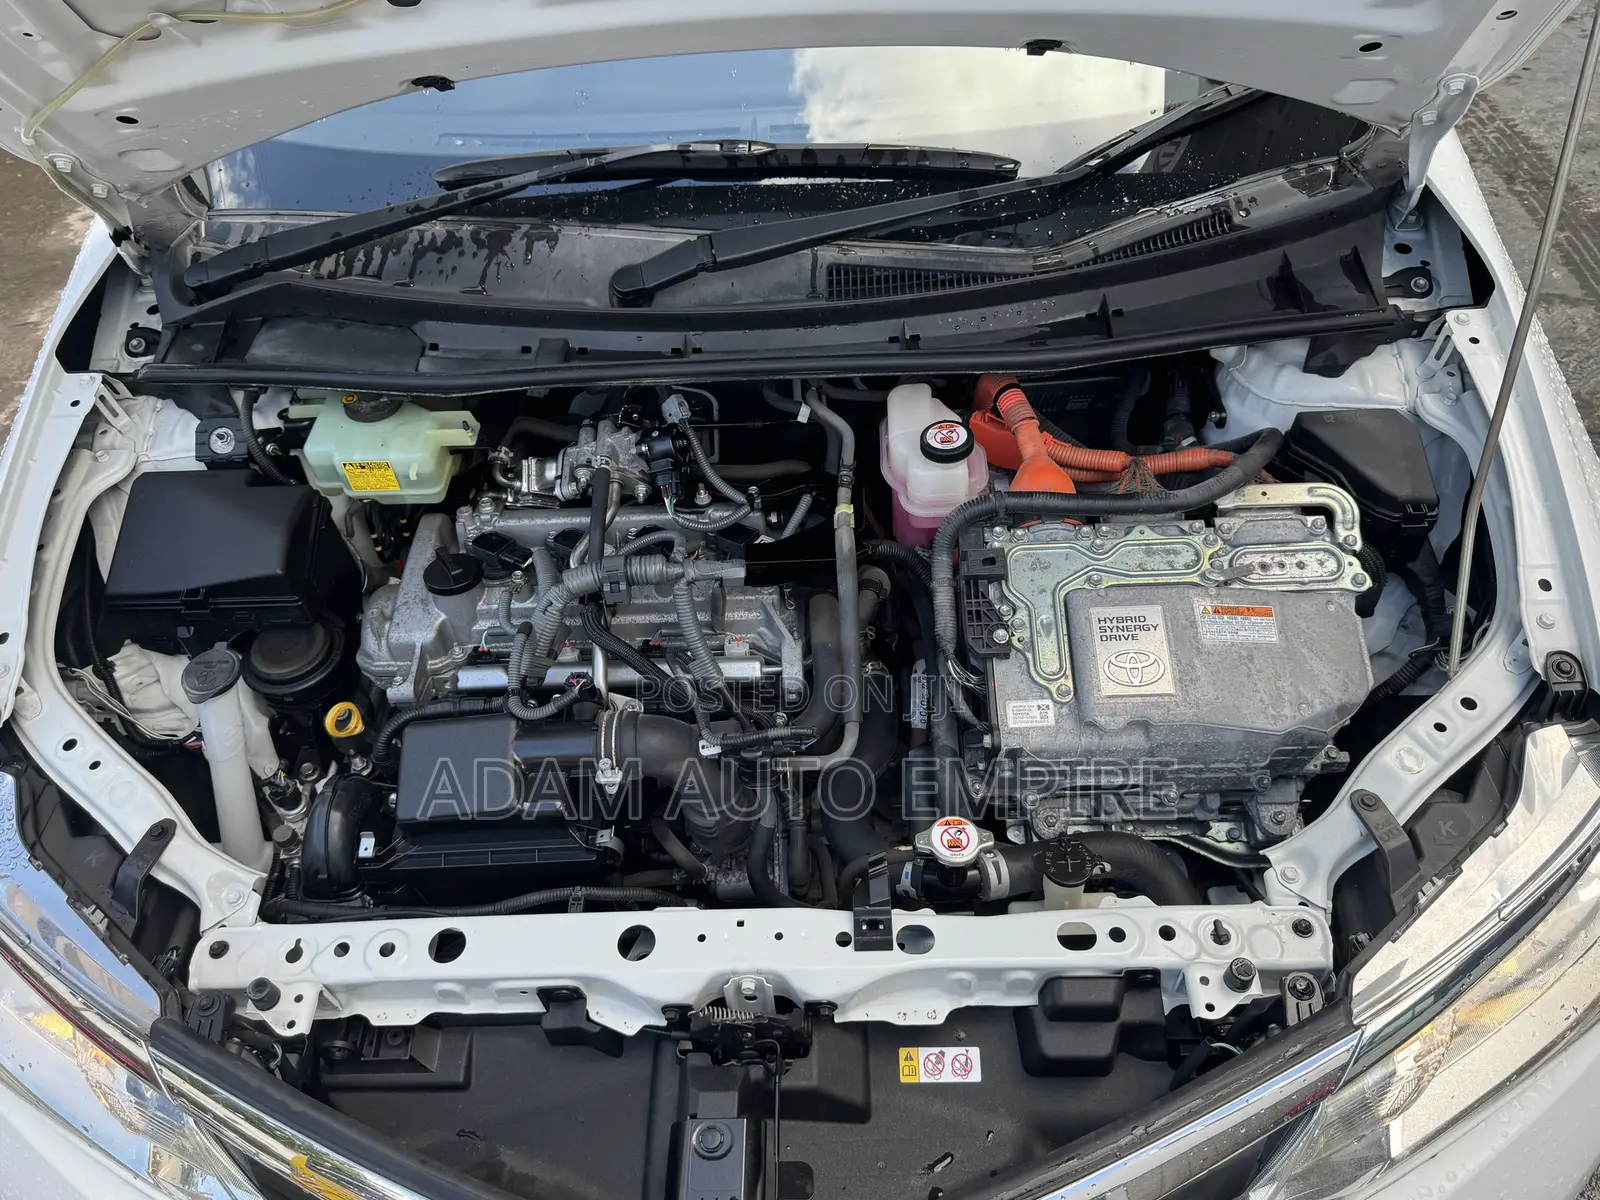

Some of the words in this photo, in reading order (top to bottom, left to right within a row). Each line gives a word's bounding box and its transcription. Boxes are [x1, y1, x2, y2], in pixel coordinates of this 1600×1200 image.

[1097, 615, 1147, 625] HYBRID
[1098, 623, 1159, 634] SYNERGY
[1100, 633, 1139, 642] DRIVE
